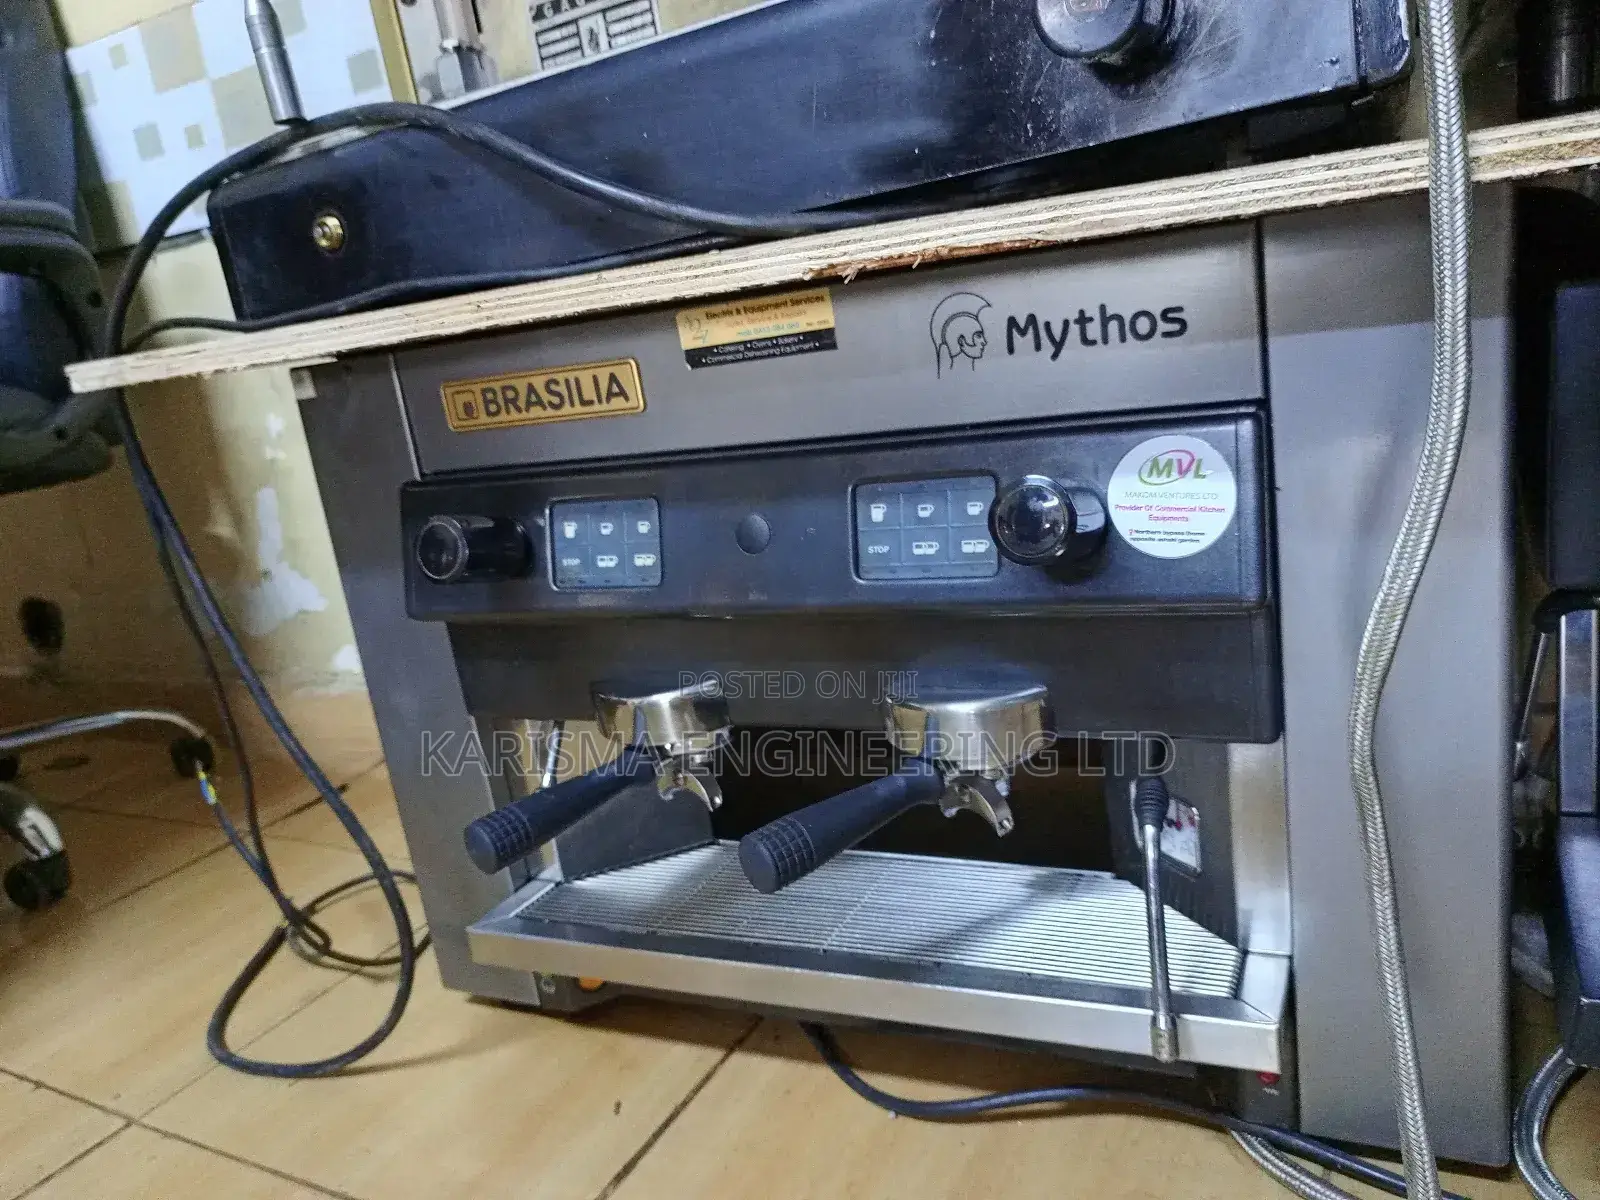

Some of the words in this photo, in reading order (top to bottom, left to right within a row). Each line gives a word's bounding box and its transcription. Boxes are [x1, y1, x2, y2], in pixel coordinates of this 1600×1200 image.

[1006, 303, 1188, 361] Mythos
[480, 372, 630, 418] BRASILIA
[1146, 456, 1207, 479] MVL
[1159, 491, 1200, 500] VENTURES
[1198, 505, 1226, 513] Kitchen
[1148, 514, 1189, 522] Equipments
[867, 545, 890, 554] STOP
